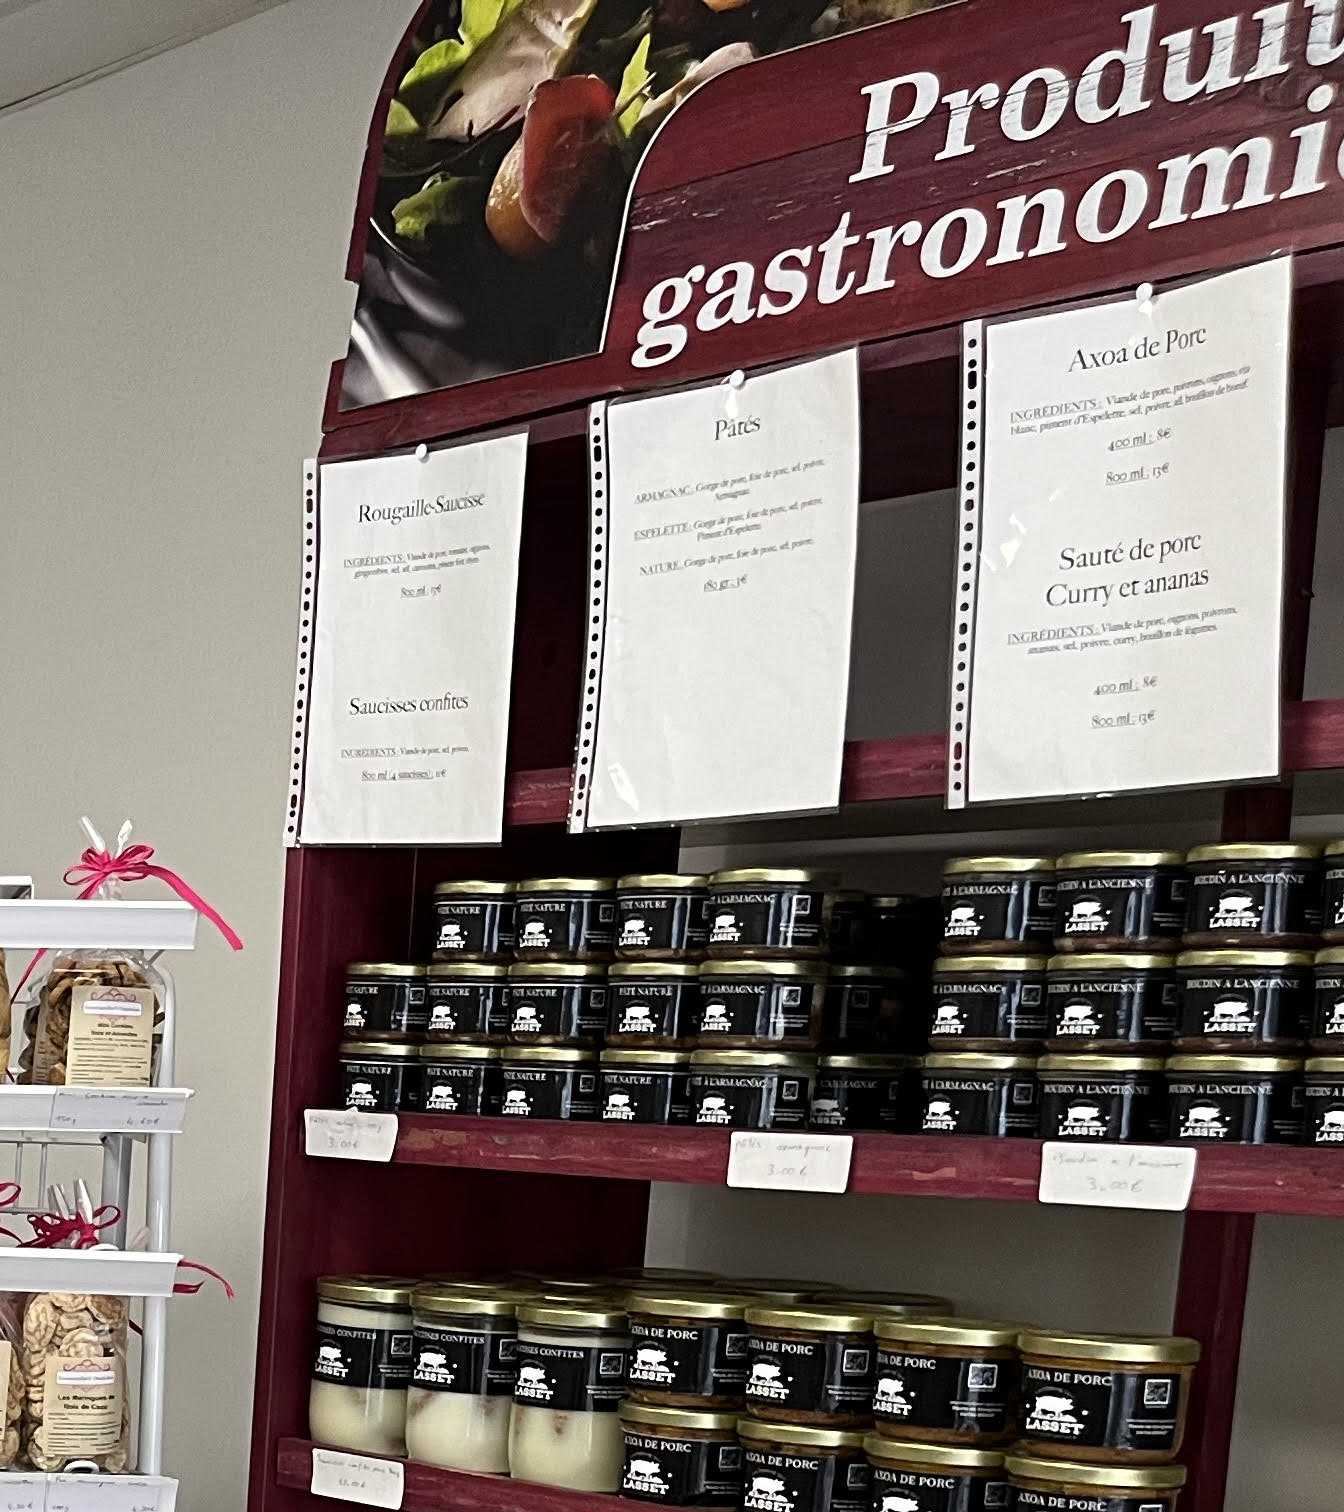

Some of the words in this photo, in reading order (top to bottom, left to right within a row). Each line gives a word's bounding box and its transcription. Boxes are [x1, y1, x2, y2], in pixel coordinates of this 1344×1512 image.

[631, 83, 1344, 370] gastronomi
[1067, 347, 1129, 373] Axoa
[1134, 336, 1160, 360] de
[1166, 327, 1206, 354] Porc
[714, 415, 761, 441] Pâtés
[1058, 541, 1124, 571] Sauté
[1129, 538, 1155, 561] de
[1159, 533, 1202, 563] porc
[1046, 581, 1113, 607] Curry
[1118, 580, 1139, 598] et
[1144, 568, 1209, 594] ananas
[349, 697, 416, 716] Saucisses
[420, 692, 469, 713] confites
[1065, 922, 1109, 933] LASSET
[1209, 918, 1261, 928] LASSET
[1204, 1022, 1257, 1033] LASSET
[1058, 1126, 1108, 1137] LASSET
[1179, 1127, 1229, 1138] LASSET
[336, 1329, 377, 1340] CONFITES
[440, 1333, 485, 1345] CONFITES
[539, 1347, 584, 1359] CONFITES
[413, 1369, 455, 1384] LASSET
[1054, 1372, 1071, 1383] DE
[1074, 1374, 1112, 1386] PORC
[514, 1386, 554, 1400] LASSET
[1025, 1418, 1085, 1435] LASSET
[644, 1439, 659, 1450] DE
[661, 1441, 691, 1453] PORC
[768, 1456, 783, 1467] DE
[785, 1459, 819, 1470] PORC
[899, 1473, 916, 1485] DE
[919, 1476, 955, 1489] PORC
[1048, 1497, 1066, 1508] DE
[1069, 1499, 1108, 1512] PORC
